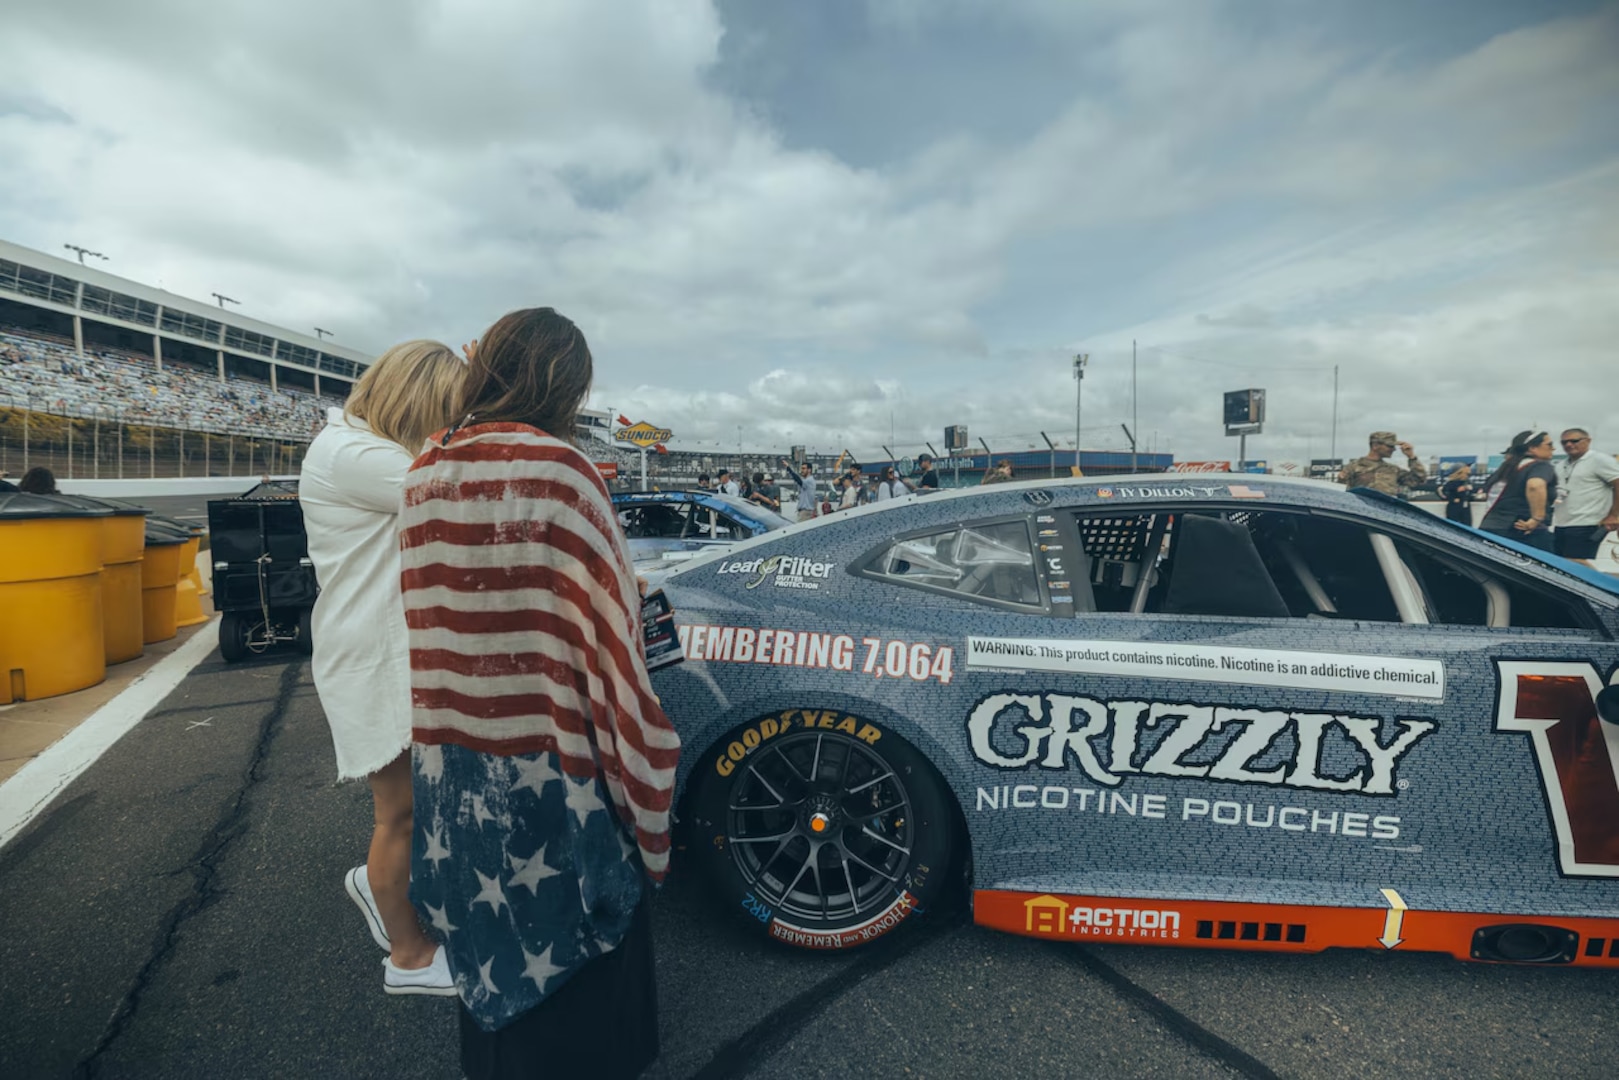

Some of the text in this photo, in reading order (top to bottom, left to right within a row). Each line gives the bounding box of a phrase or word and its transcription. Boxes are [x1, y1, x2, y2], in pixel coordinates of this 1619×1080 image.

[619, 429, 669, 441] SUNOCO
[1116, 487, 1195, 498] TY DILLON
[774, 580, 819, 590] PROTECTION
[776, 574, 803, 582] GUTTER
[863, 637, 953, 684] 7,064
[973, 640, 1439, 685] WARNING: This product contains nicotine. Nicotine is an addictive chemical.
[966, 692, 1438, 796] GRIZZLY
[976, 784, 1400, 839] NICOTINE POUCHES
[862, 910, 905, 940] HONOR
[1069, 907, 1180, 930] ACTION
[773, 925, 842, 948] REMEMBER
[1072, 926, 1180, 939] INDUSTRIES
